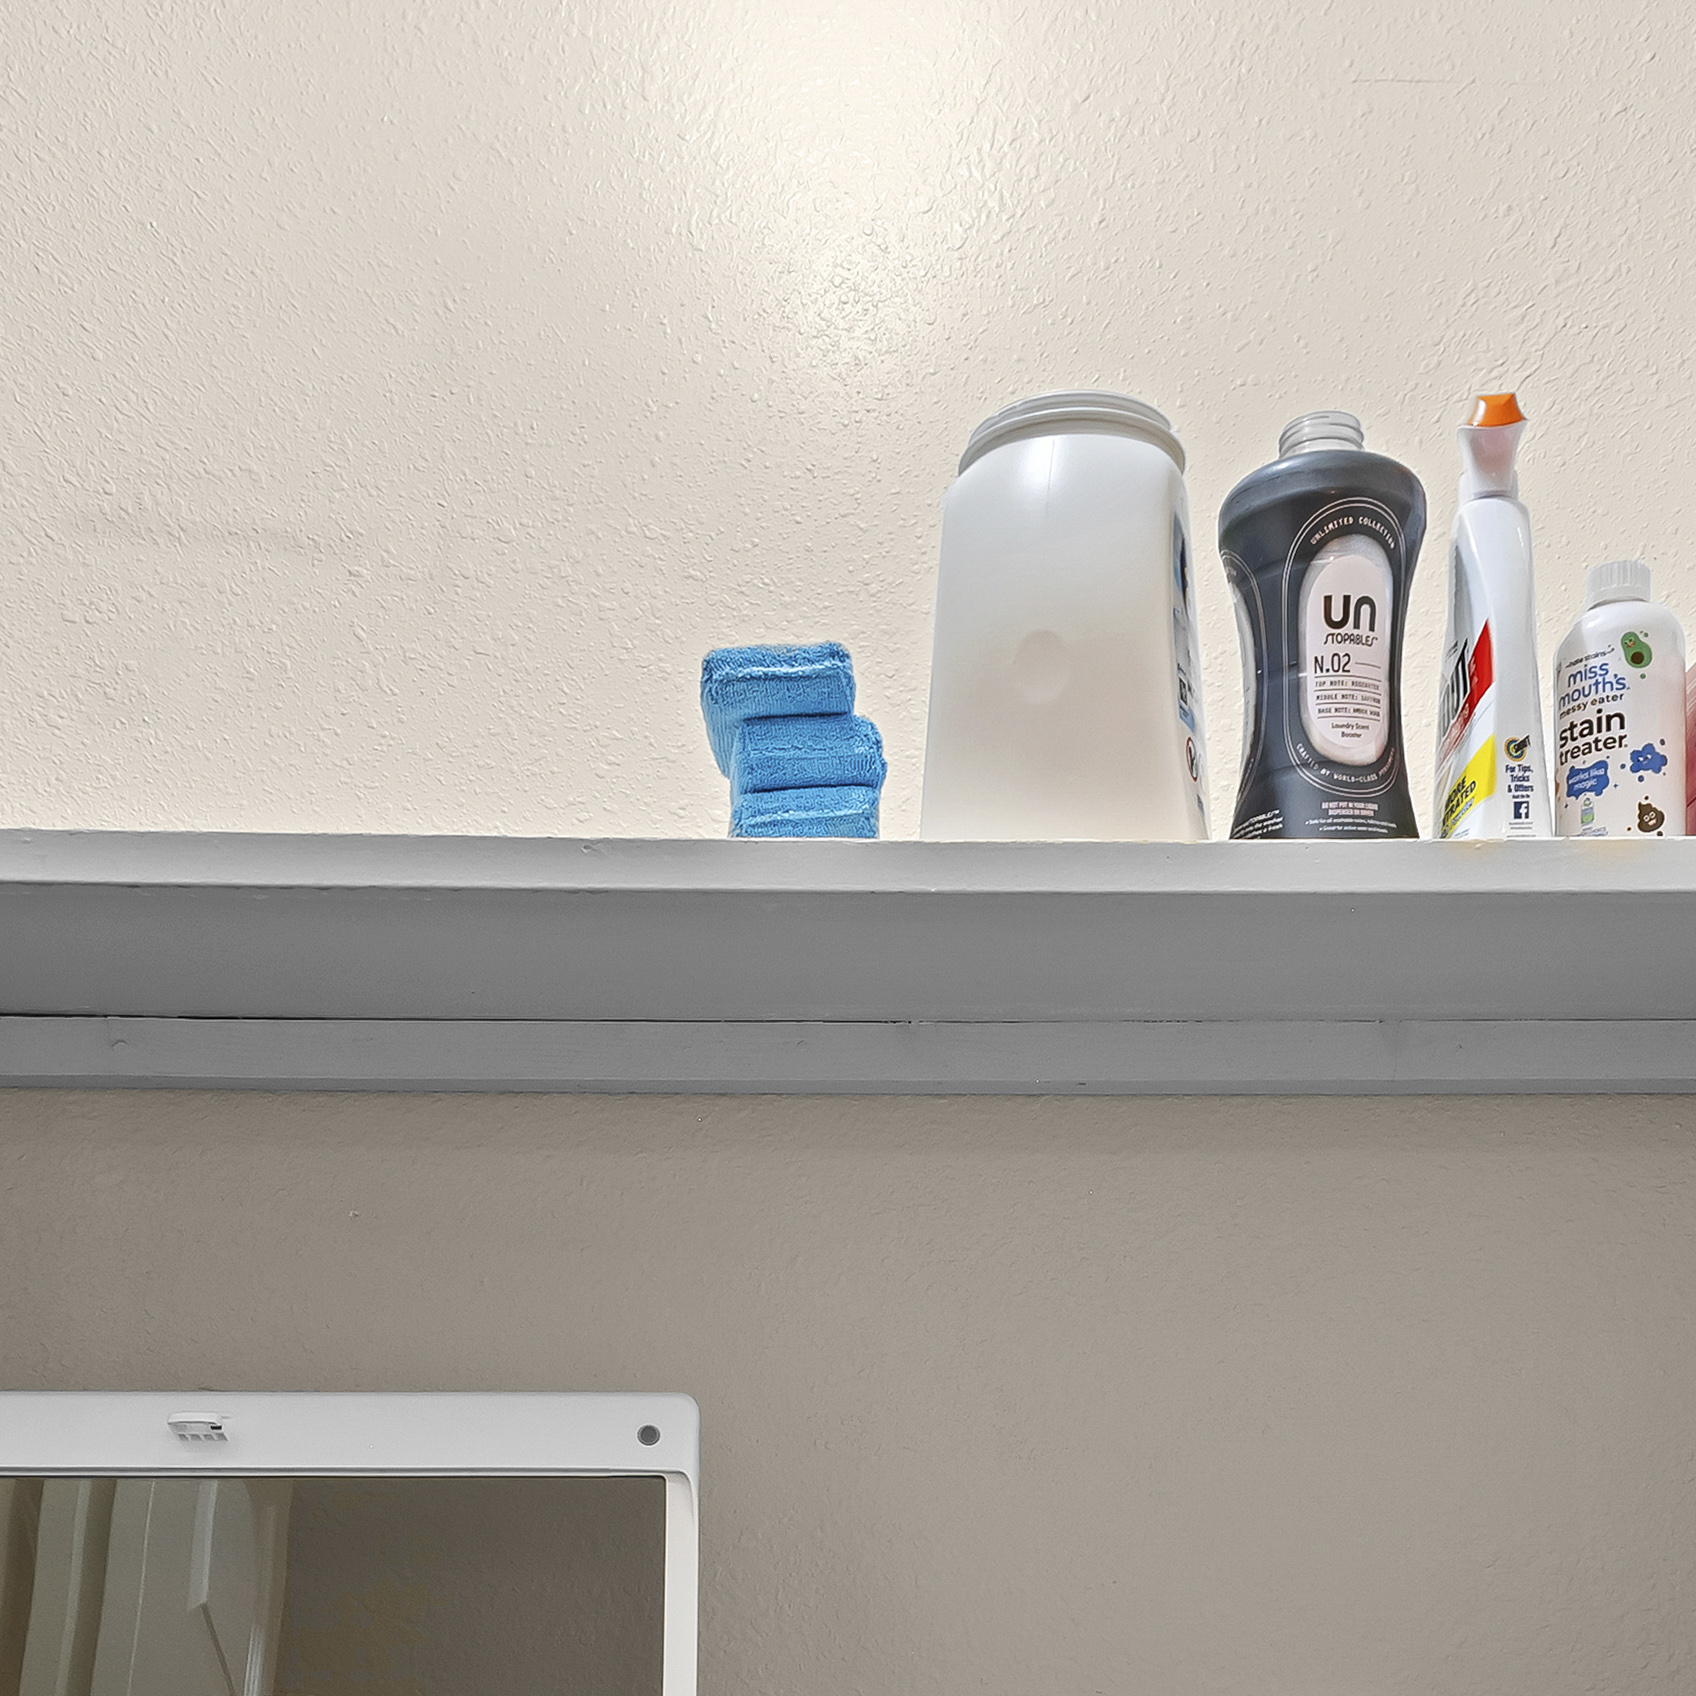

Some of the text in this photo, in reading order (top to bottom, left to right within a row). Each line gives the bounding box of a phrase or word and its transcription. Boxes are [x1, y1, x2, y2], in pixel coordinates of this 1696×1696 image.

[1310, 516, 1396, 549] UNLIMITED COLLECTION
[1314, 653, 1351, 674] N.02
[1568, 662, 1609, 688] miss
[1559, 692, 1624, 720] messy eater
[1331, 722, 1354, 731] Laundry
[1559, 708, 1625, 749] stain
[1296, 743, 1319, 770] CRAFTED
[1505, 764, 1516, 773] For
[1510, 774, 1530, 783] Tricks
[1514, 783, 1534, 792] Offers
